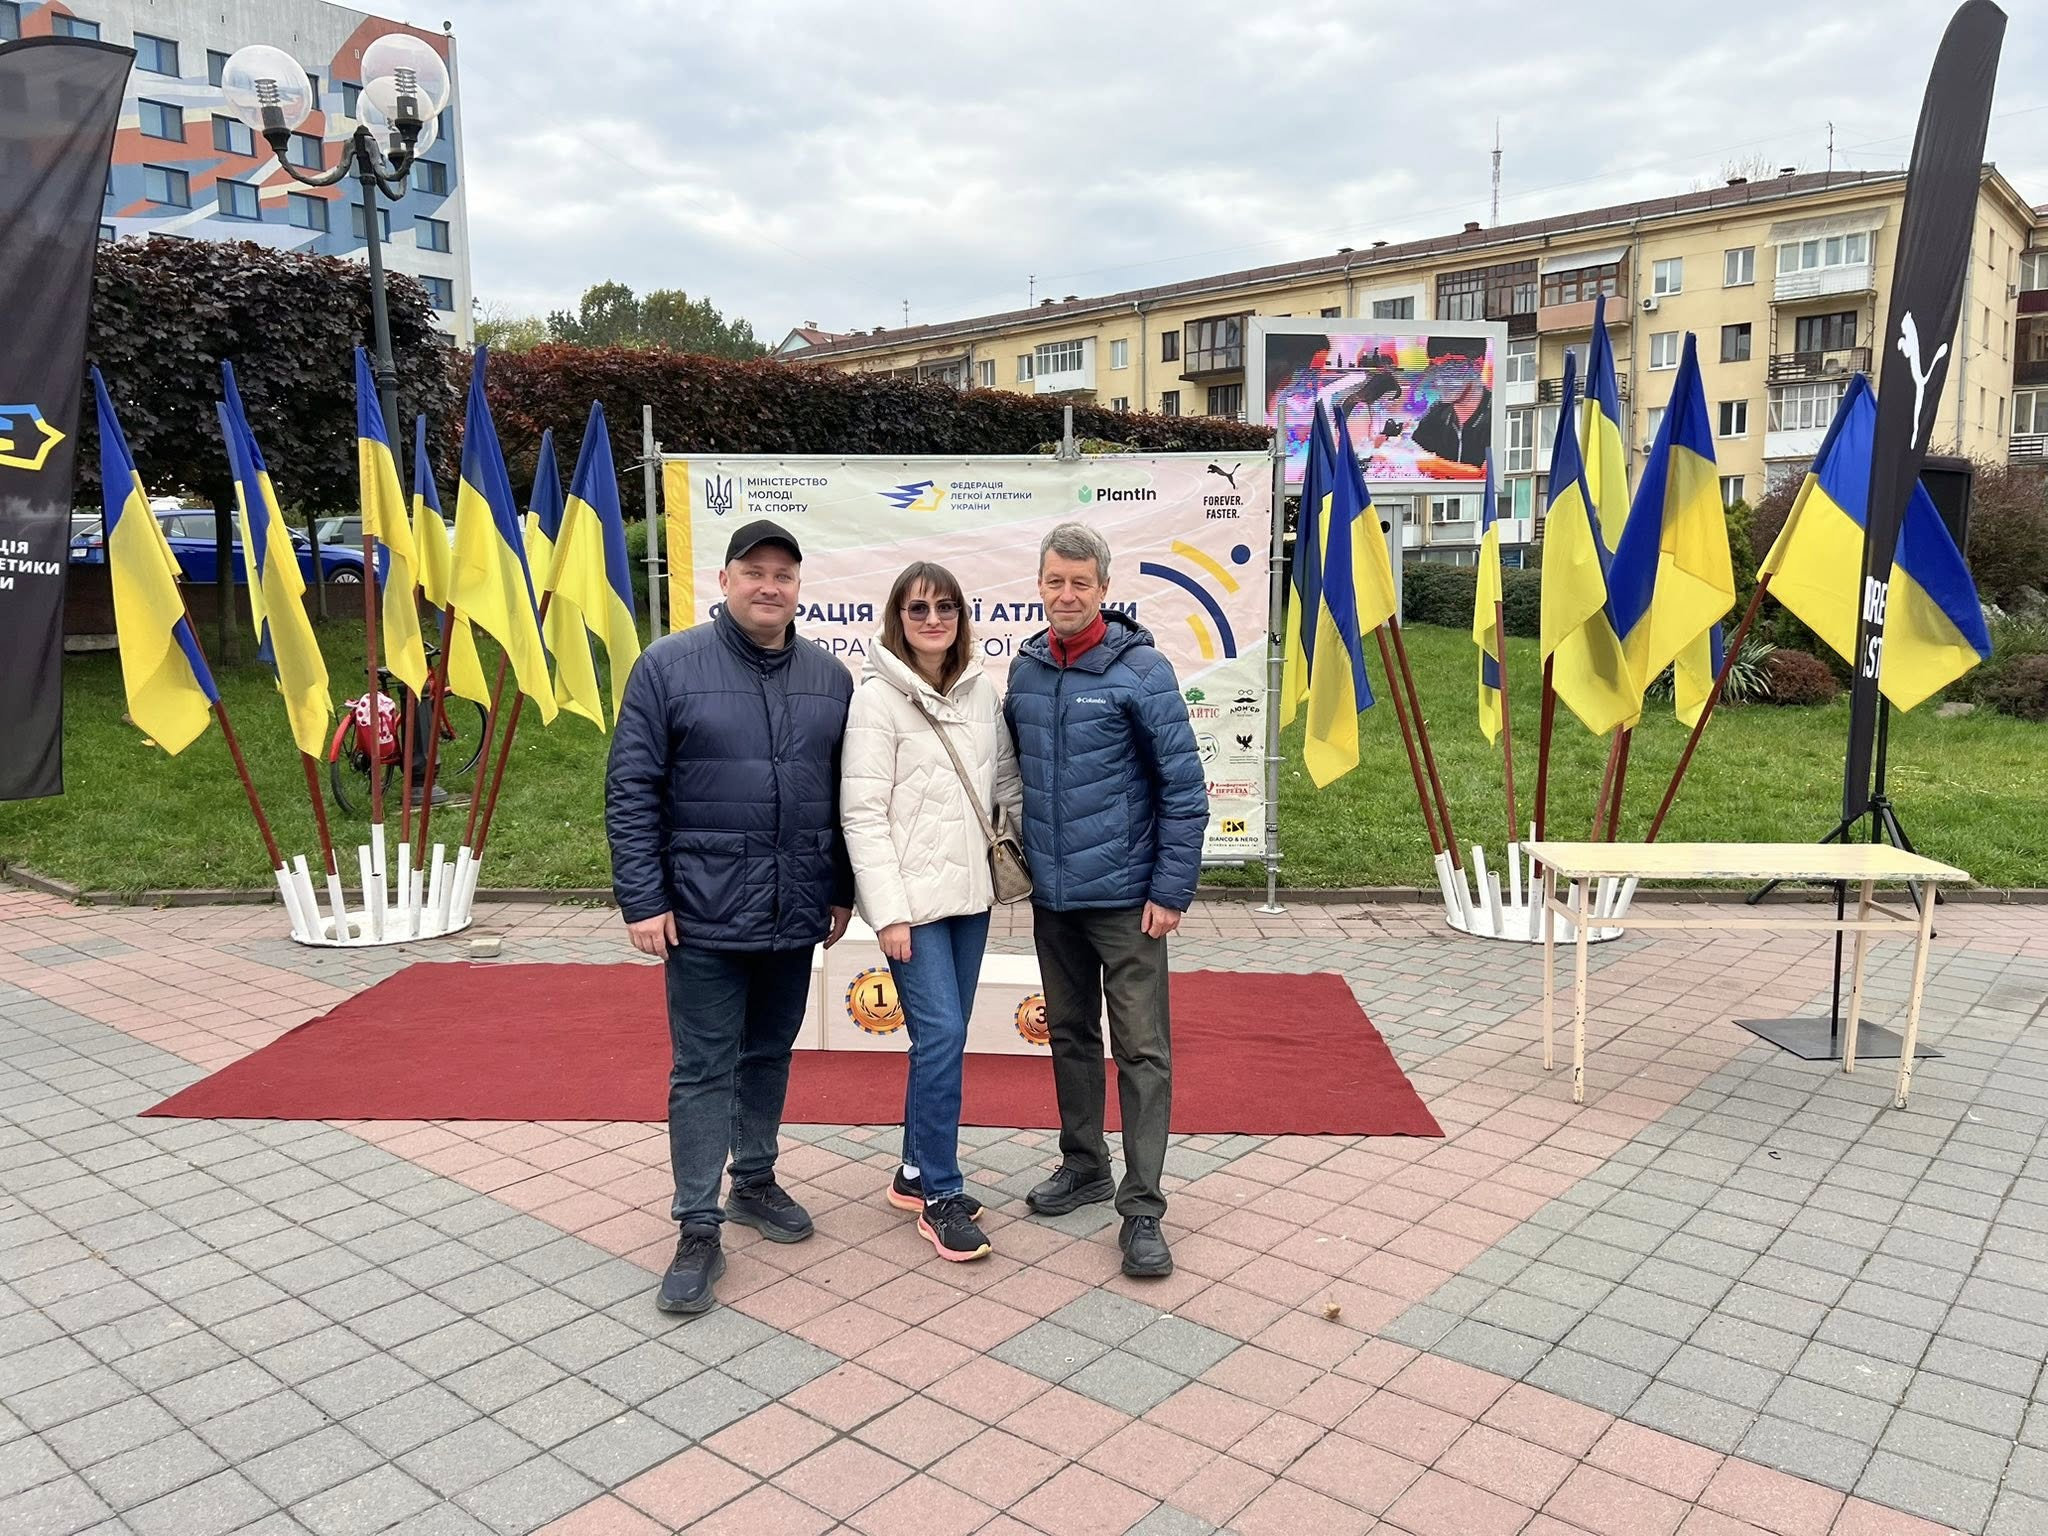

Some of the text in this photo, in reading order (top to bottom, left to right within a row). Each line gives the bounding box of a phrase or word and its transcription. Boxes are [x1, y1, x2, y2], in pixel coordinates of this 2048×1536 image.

[747, 477, 828, 486] МІНІСТЕРСТВО
[950, 481, 1003, 490] ФЕДЕРАЦІЯ
[748, 490, 793, 500] МОЛОДІ
[950, 491, 1032, 500] ЛЕГКОЇ АТЛЕТИКИ
[1203, 495, 1244, 506] FOREVER.
[748, 503, 808, 512] ТА СПОРТУ
[950, 503, 990, 511] УКРАЇНИ
[1206, 508, 1240, 519] FASTER.
[873, 984, 888, 1008] 1
